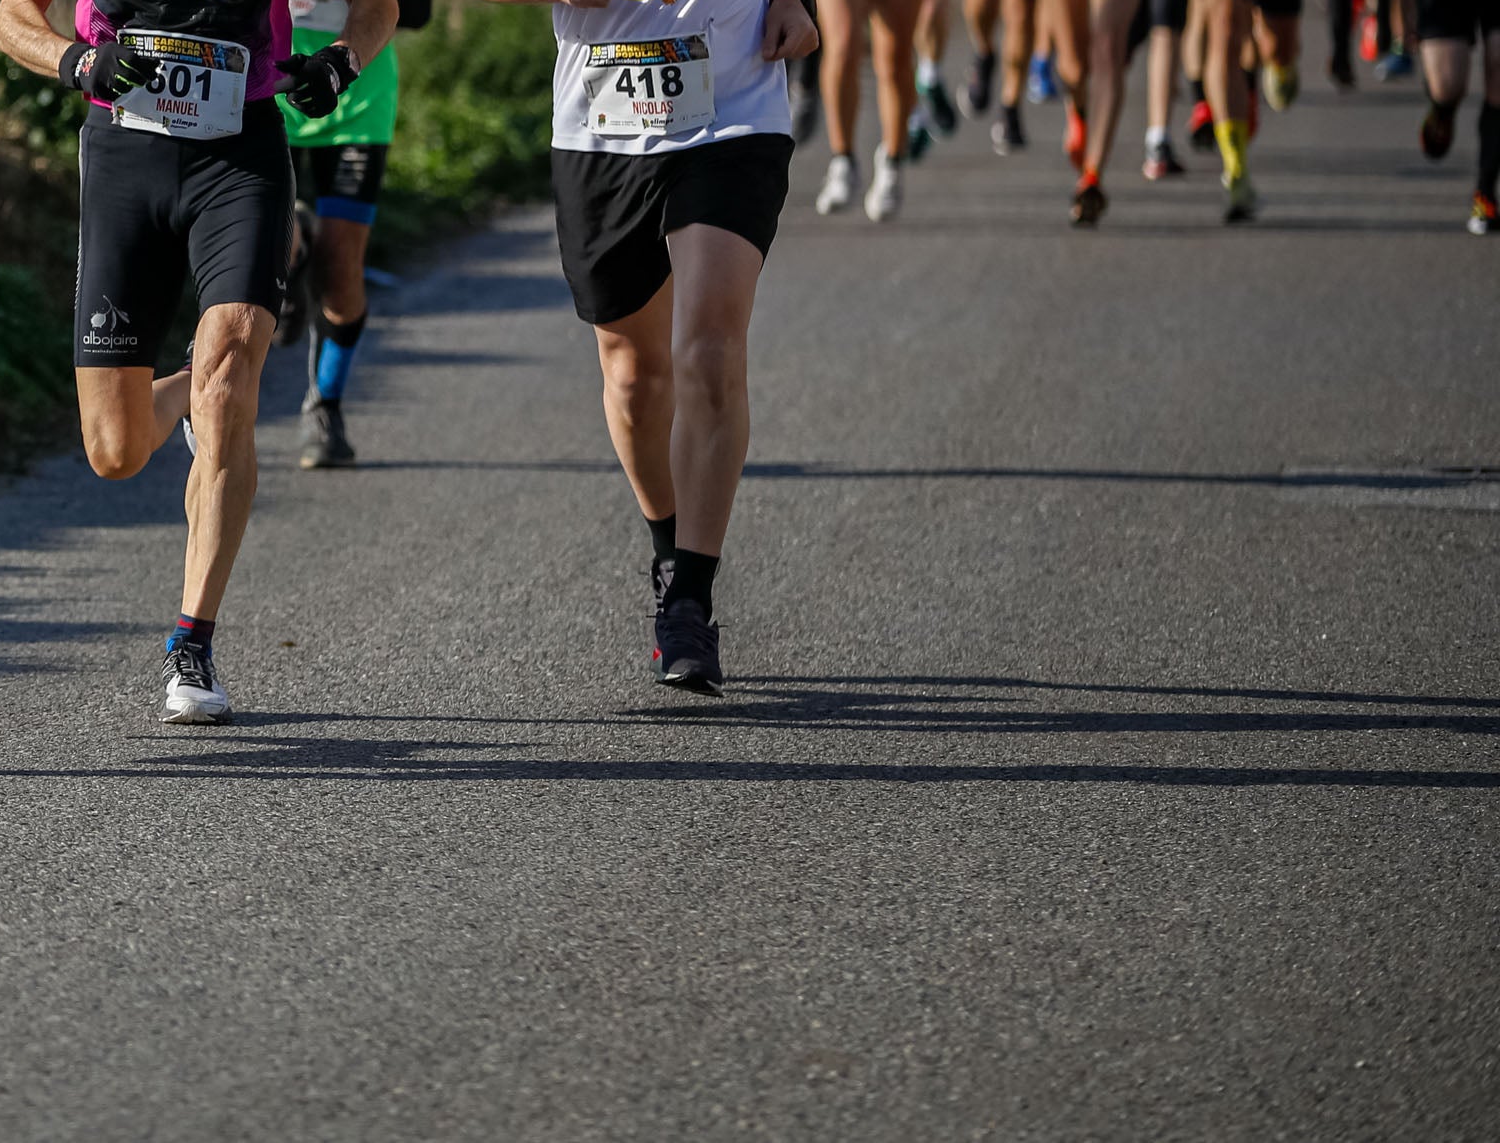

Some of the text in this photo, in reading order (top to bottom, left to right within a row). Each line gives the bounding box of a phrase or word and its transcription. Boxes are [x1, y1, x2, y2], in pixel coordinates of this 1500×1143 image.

[154, 37, 201, 51] CARRERA
[154, 45, 201, 57] POPULAR
[616, 65, 684, 98] 418
[156, 98, 200, 117] MANUEL
[633, 100, 674, 115] NICOLAS
[172, 118, 198, 128] olimpo
[83, 330, 138, 349] albojaira
